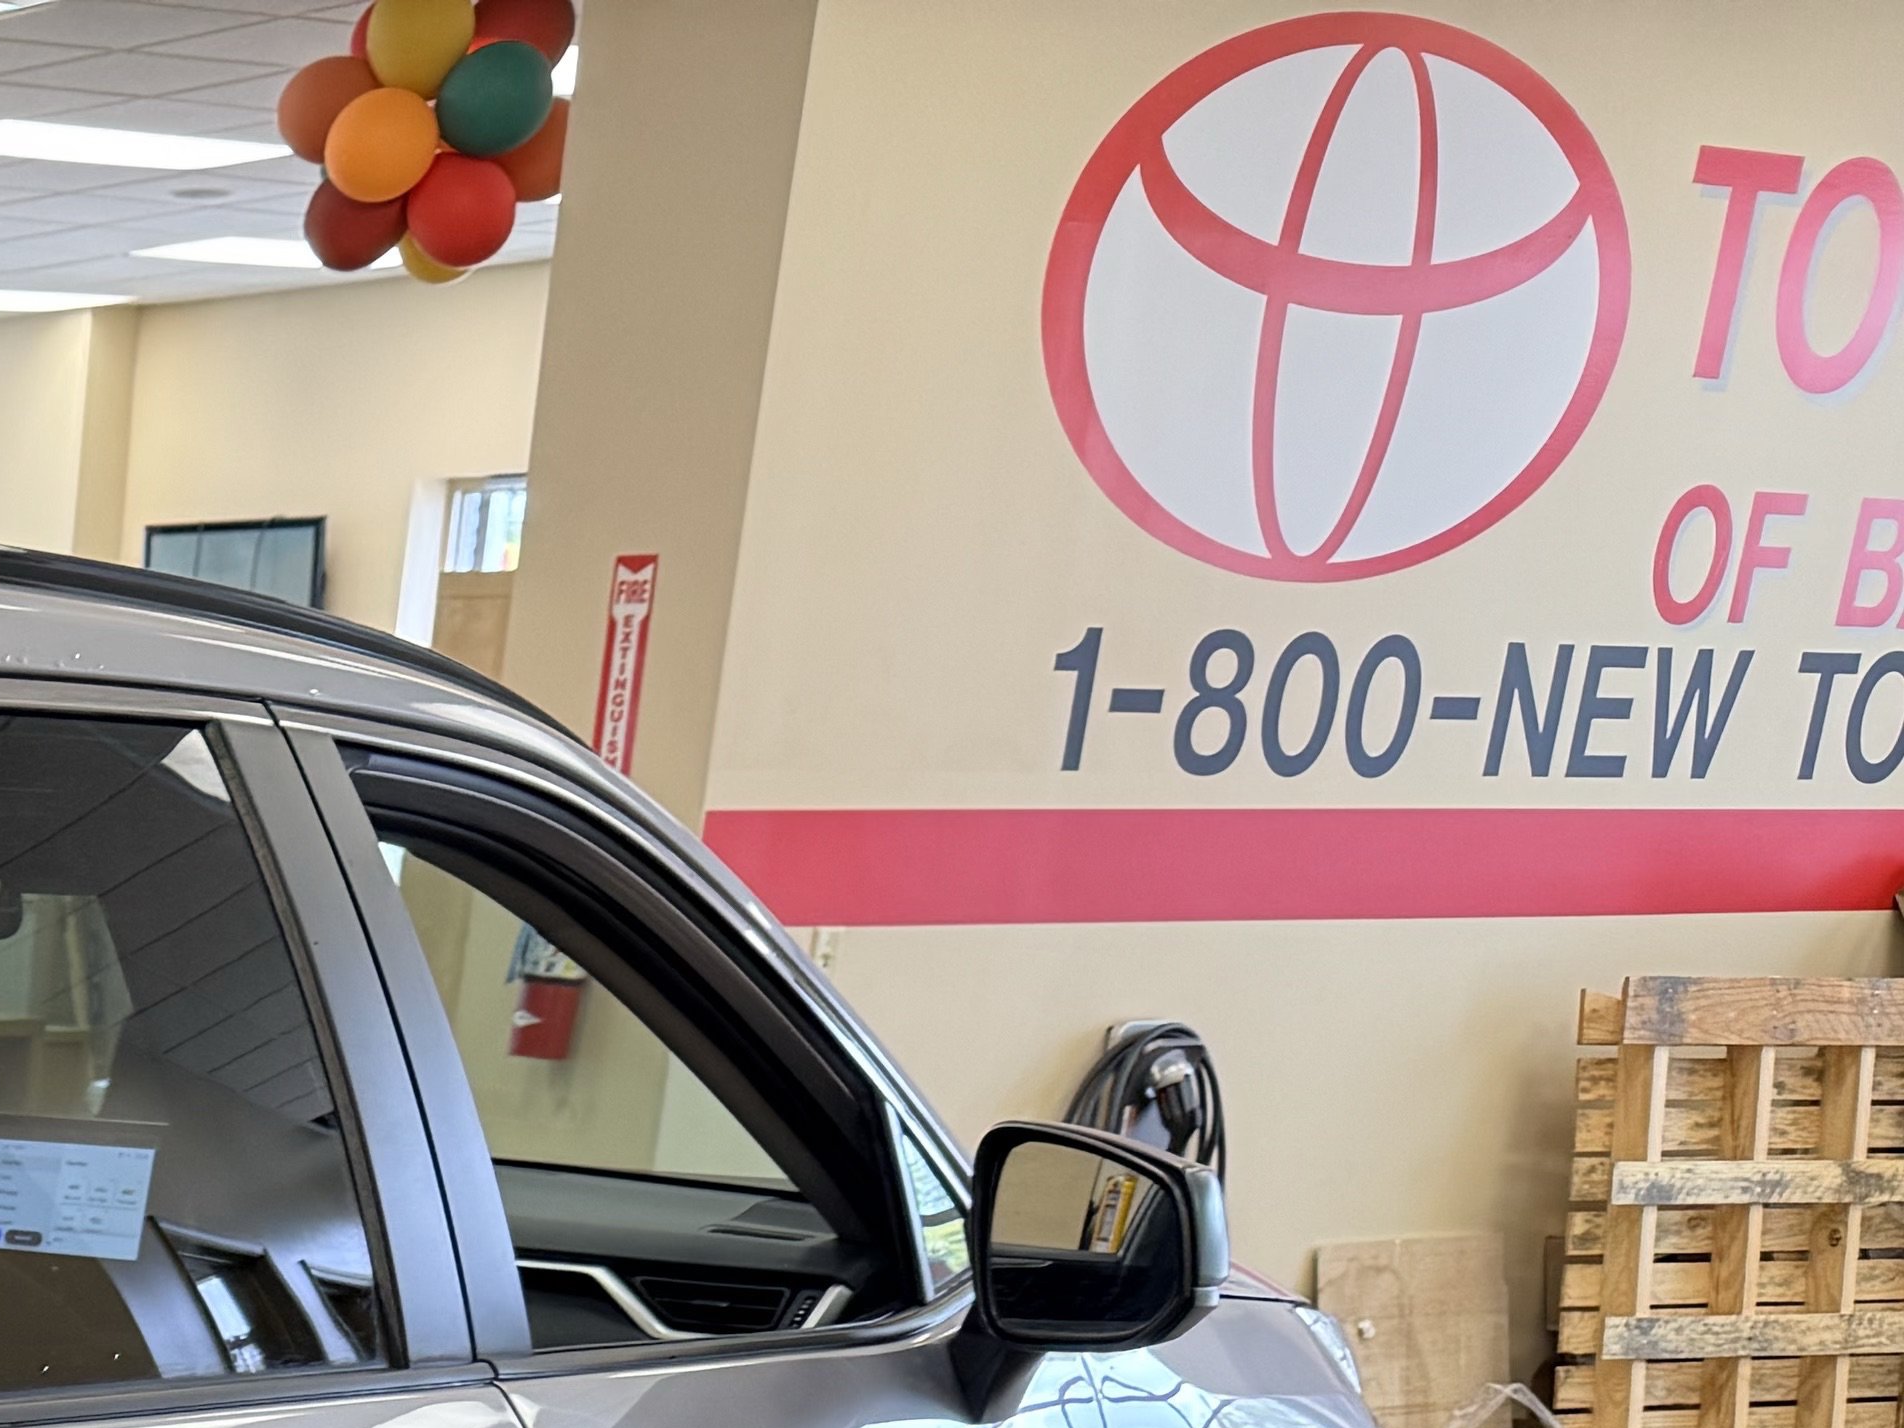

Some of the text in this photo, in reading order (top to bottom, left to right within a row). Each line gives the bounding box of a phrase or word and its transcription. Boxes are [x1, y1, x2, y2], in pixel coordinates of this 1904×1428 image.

[1693, 144, 1904, 396] TO
[615, 579, 649, 604] FIRE
[1652, 483, 1904, 630] OF B
[1051, 625, 1904, 785] 1-800-NEW TO
